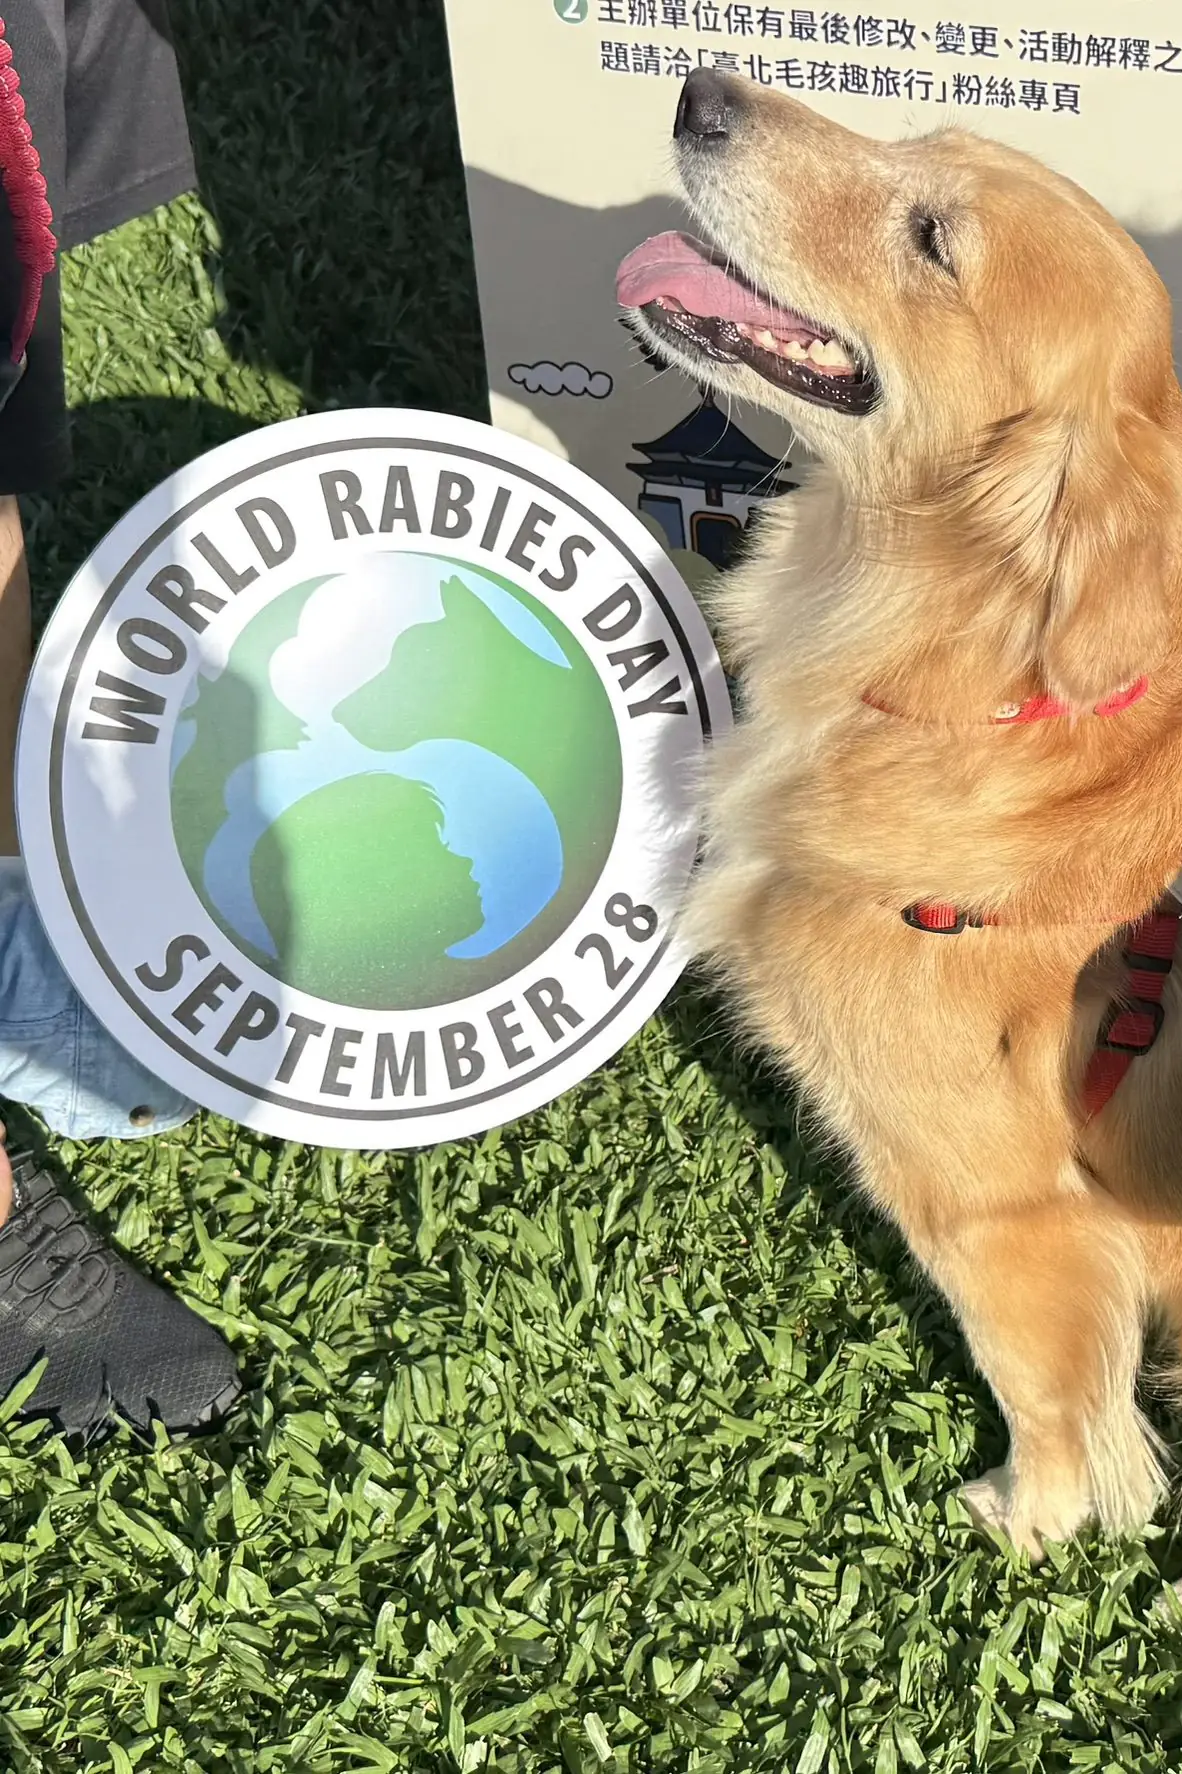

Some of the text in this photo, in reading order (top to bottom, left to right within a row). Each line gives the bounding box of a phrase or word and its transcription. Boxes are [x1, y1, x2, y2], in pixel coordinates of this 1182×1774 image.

[562, 0, 581, 19] 2
[81, 465, 688, 745] WORLD RABIES DAY
[134, 891, 658, 1100] SEPTEMBER 28
